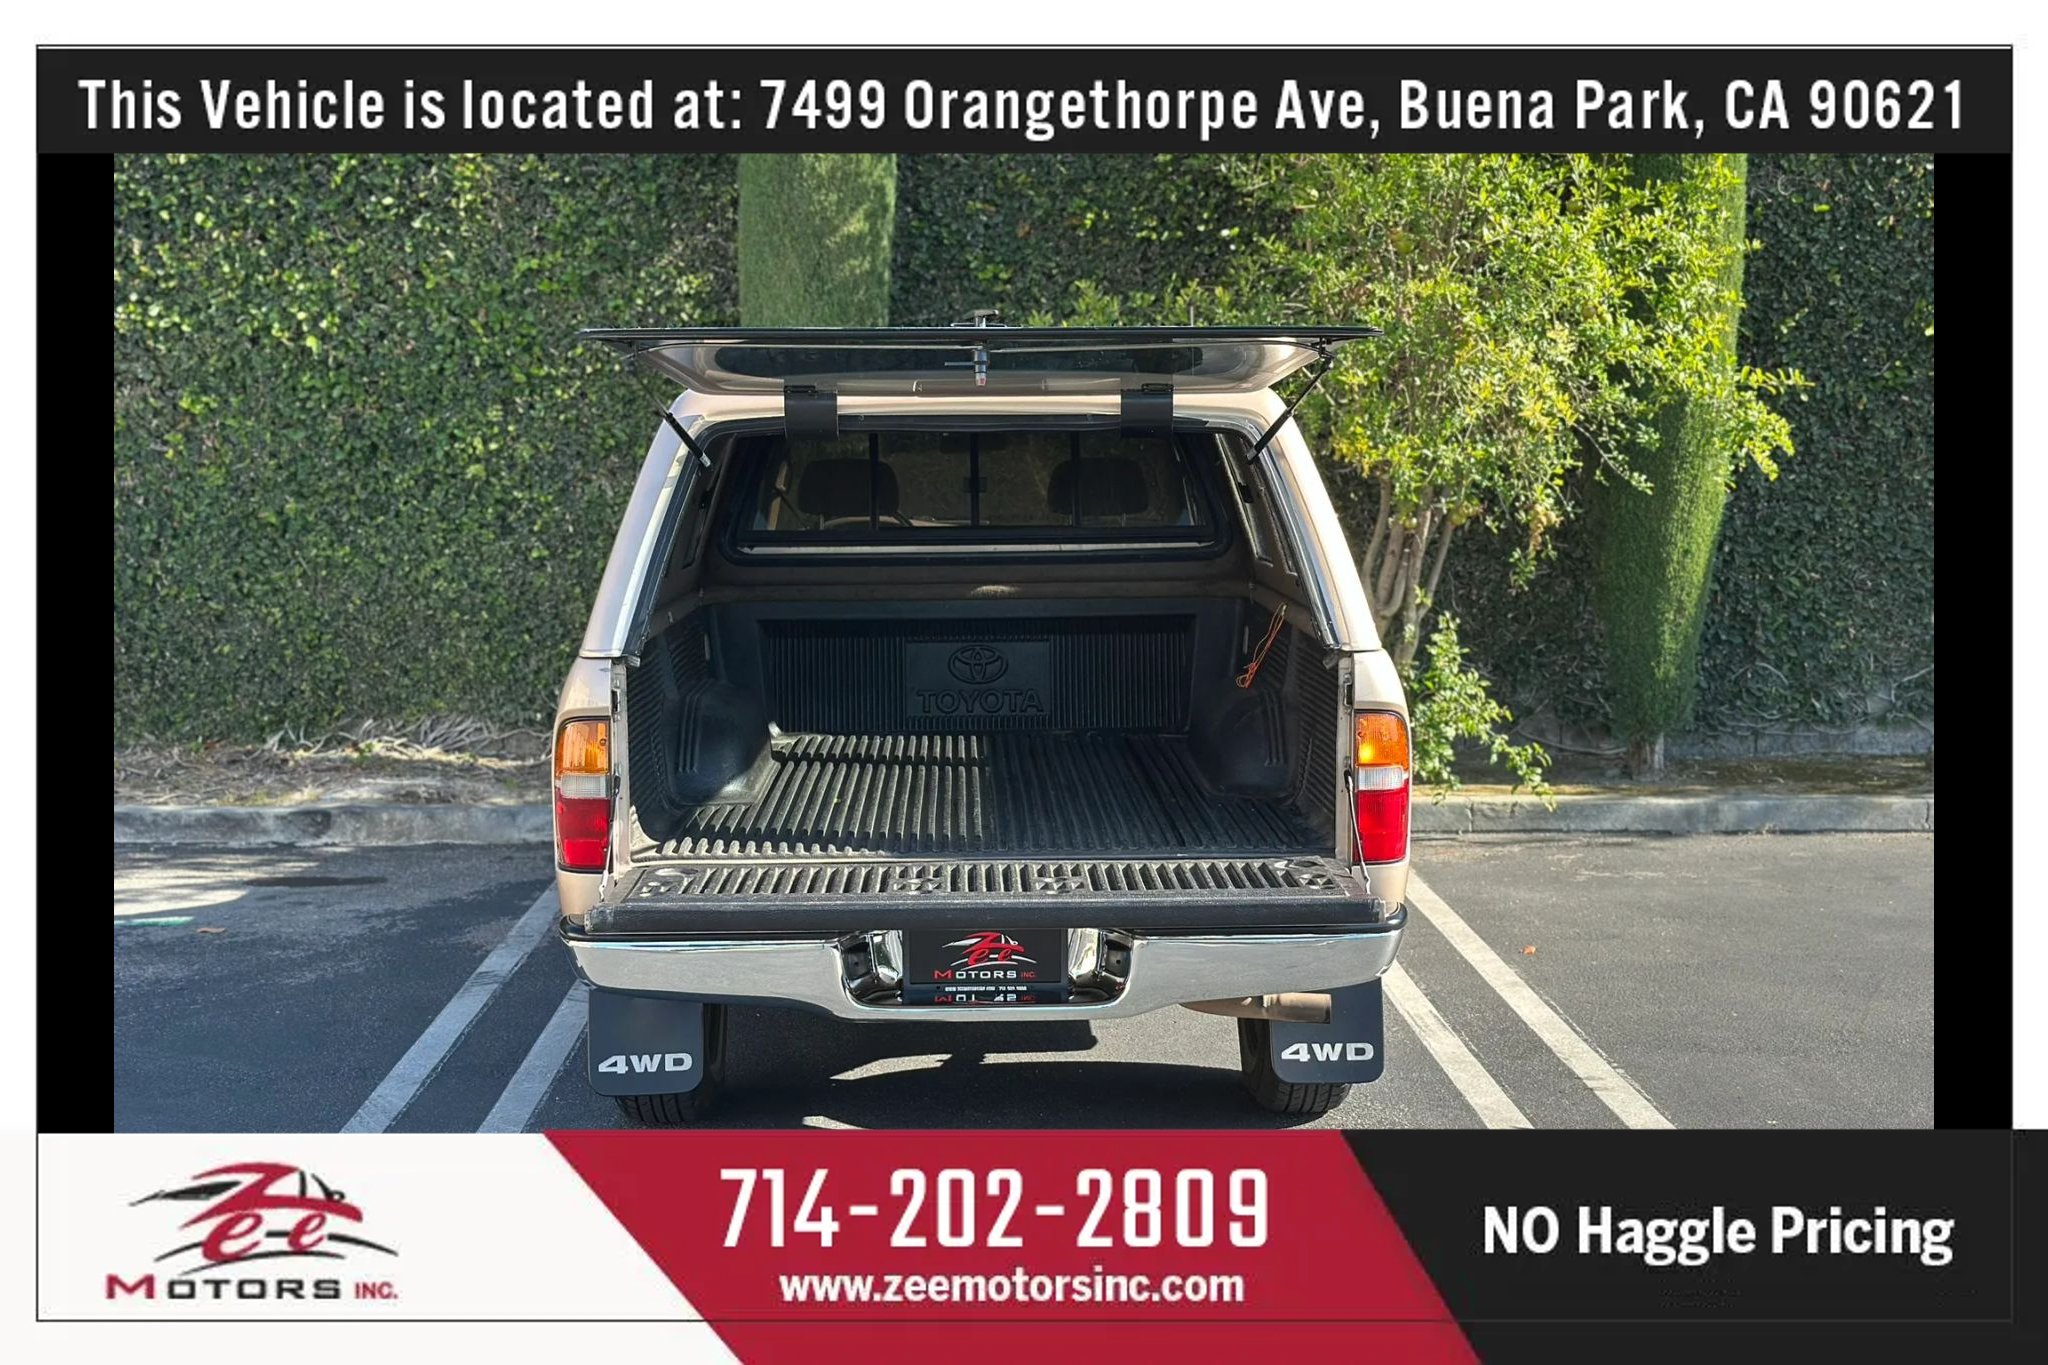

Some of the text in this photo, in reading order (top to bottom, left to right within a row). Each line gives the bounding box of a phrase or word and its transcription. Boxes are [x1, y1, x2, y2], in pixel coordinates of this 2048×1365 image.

[916, 688, 1043, 714] TOYOTA
[598, 1052, 693, 1074] 4WD
[1281, 1042, 1374, 1062] 4WD
